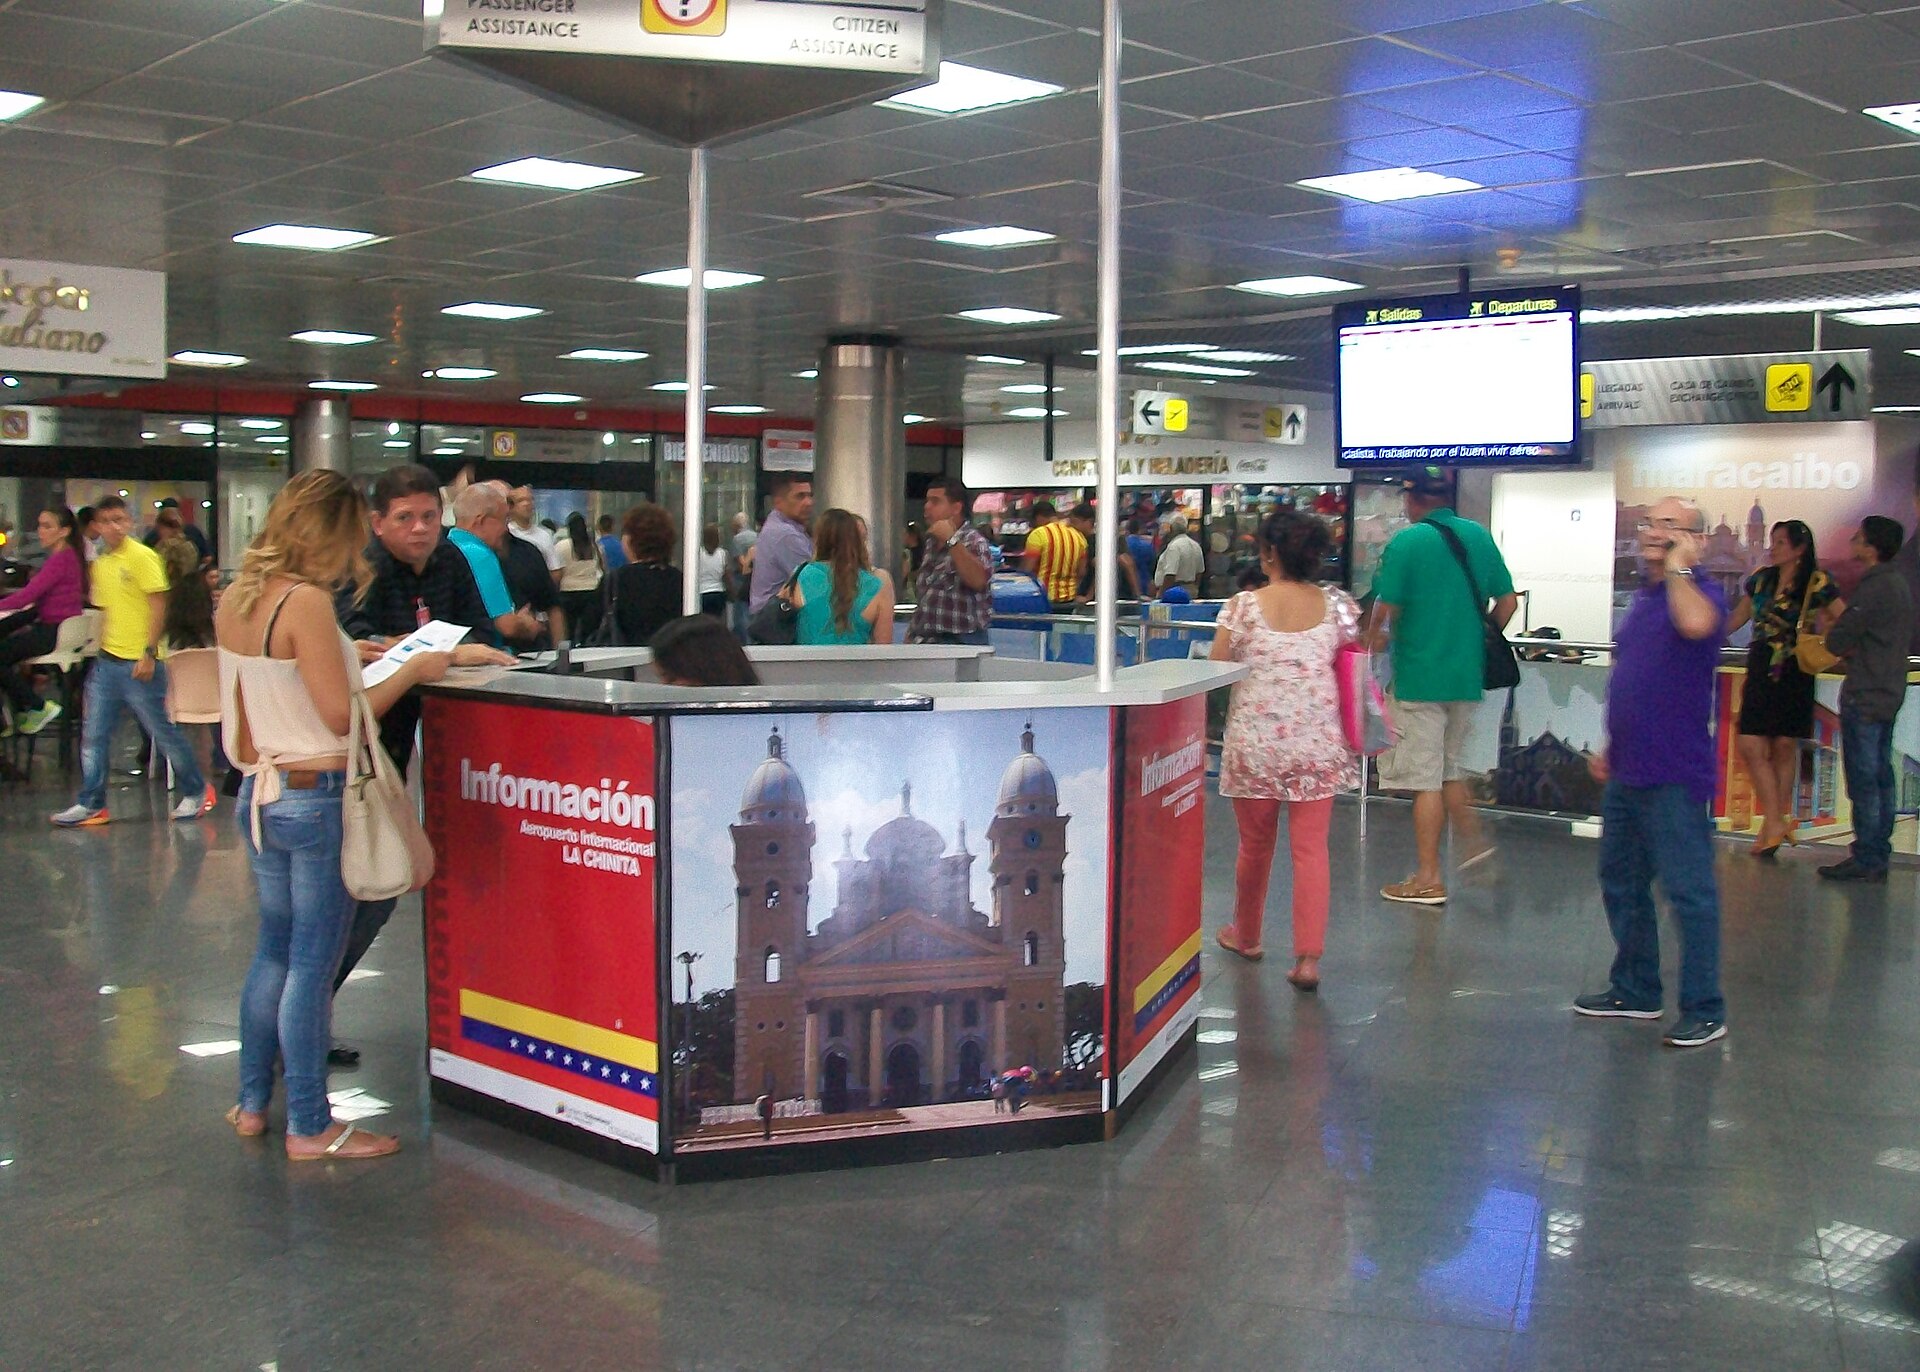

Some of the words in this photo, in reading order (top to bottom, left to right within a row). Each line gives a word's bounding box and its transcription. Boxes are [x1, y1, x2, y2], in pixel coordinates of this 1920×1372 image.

[467, 0, 576, 13] PASSENGER
[467, 18, 579, 38] ASSISTANCE
[832, 16, 898, 35] CITIZEN
[789, 38, 898, 59] ASSISTANCE
[1379, 307, 1423, 323] Salidas
[1488, 298, 1558, 316] Departures
[1597, 382, 1644, 394] LLEGADAS
[663, 441, 750, 464] BIEENIDOS
[1378, 446, 1430, 459] trabajando
[1430, 446, 1448, 458] por
[1448, 445, 1460, 457] el
[1460, 445, 1487, 457] buen
[1488, 444, 1509, 456] vivir
[1509, 443, 1541, 456] aéreo
[1136, 457, 1145, 475] Y
[1632, 452, 1862, 490] maracaibo
[460, 757, 656, 832] Información
[519, 818, 580, 843] Aeropuerto
[579, 828, 657, 858] Internacional
[562, 845, 582, 865] LA
[582, 848, 642, 878] CHINITA
